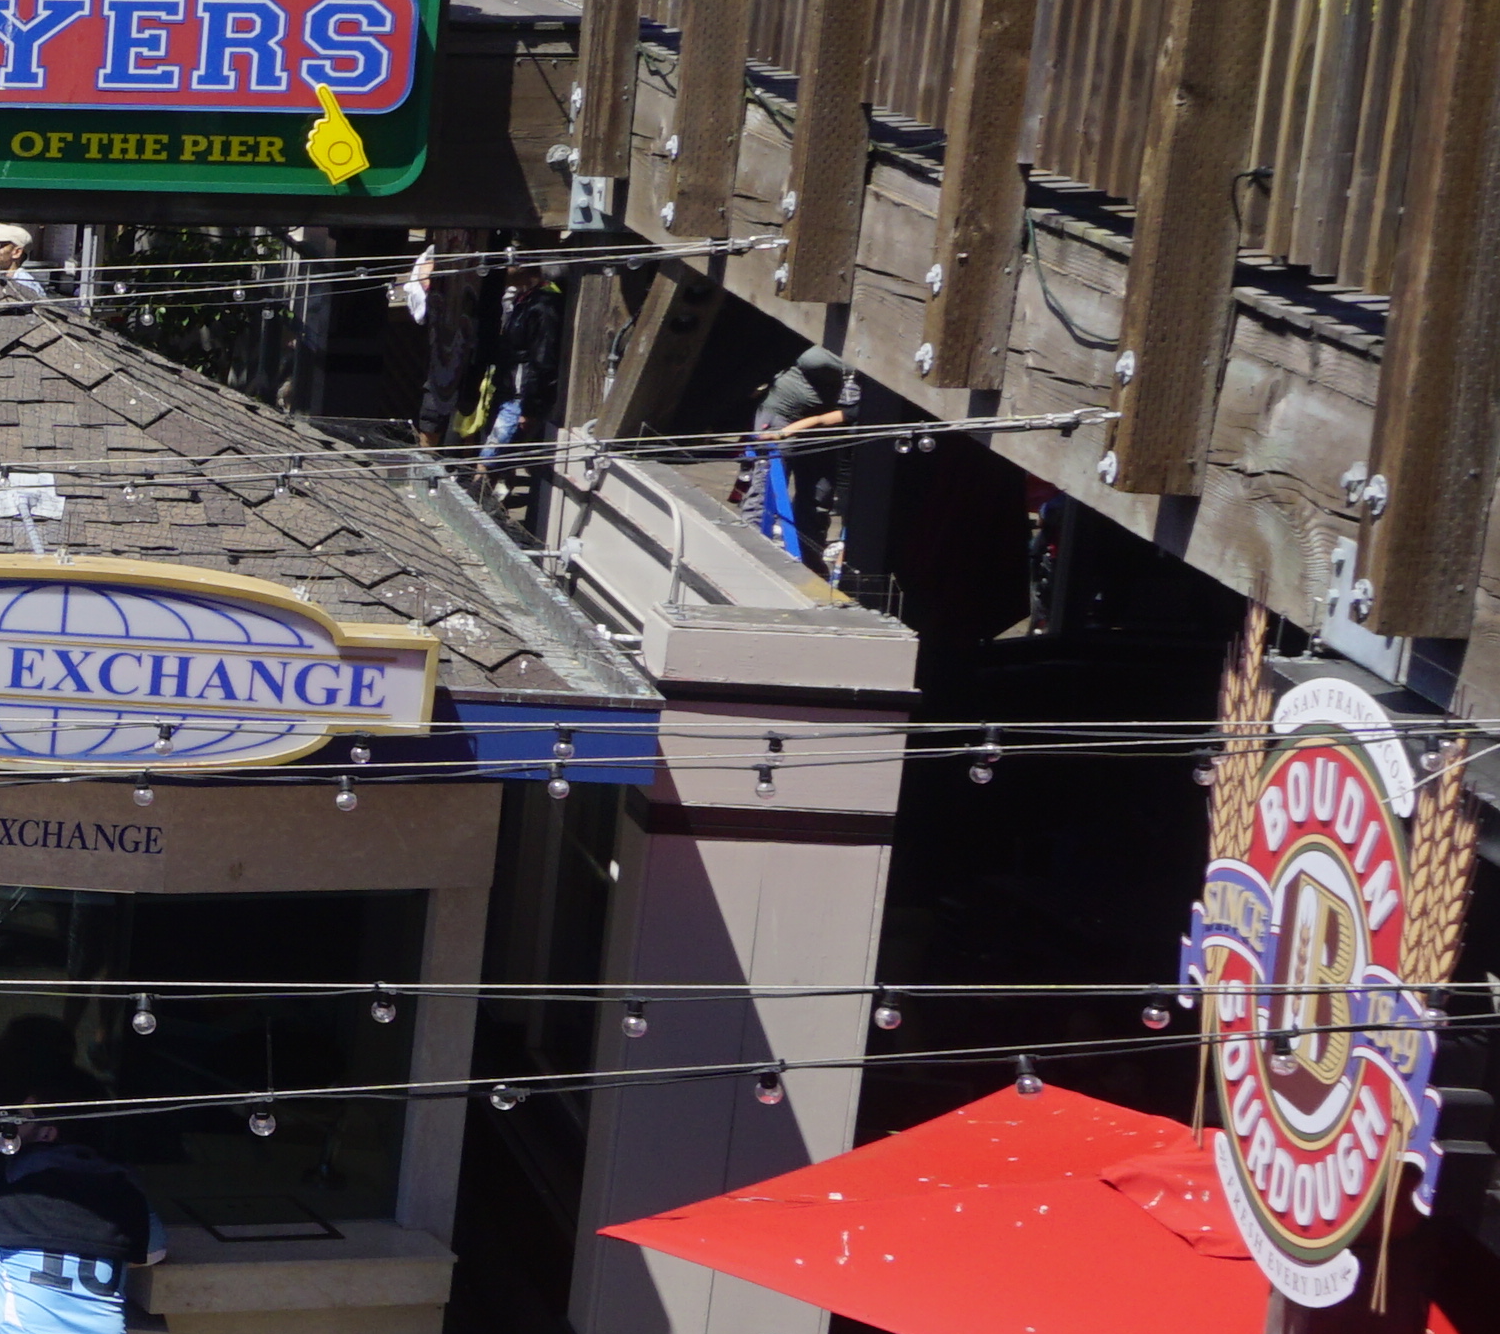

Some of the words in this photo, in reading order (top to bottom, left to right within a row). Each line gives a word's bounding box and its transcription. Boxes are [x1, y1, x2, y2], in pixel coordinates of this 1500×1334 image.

[10, 131, 73, 161] OF
[79, 132, 169, 162] THE
[180, 134, 286, 165] PIER
[6, 646, 387, 709] EXCHANGE
[1260, 756, 1399, 931] BOUDIN
[1202, 880, 1271, 953] SINCE
[1217, 978, 1386, 1227] SOURDOUGH
